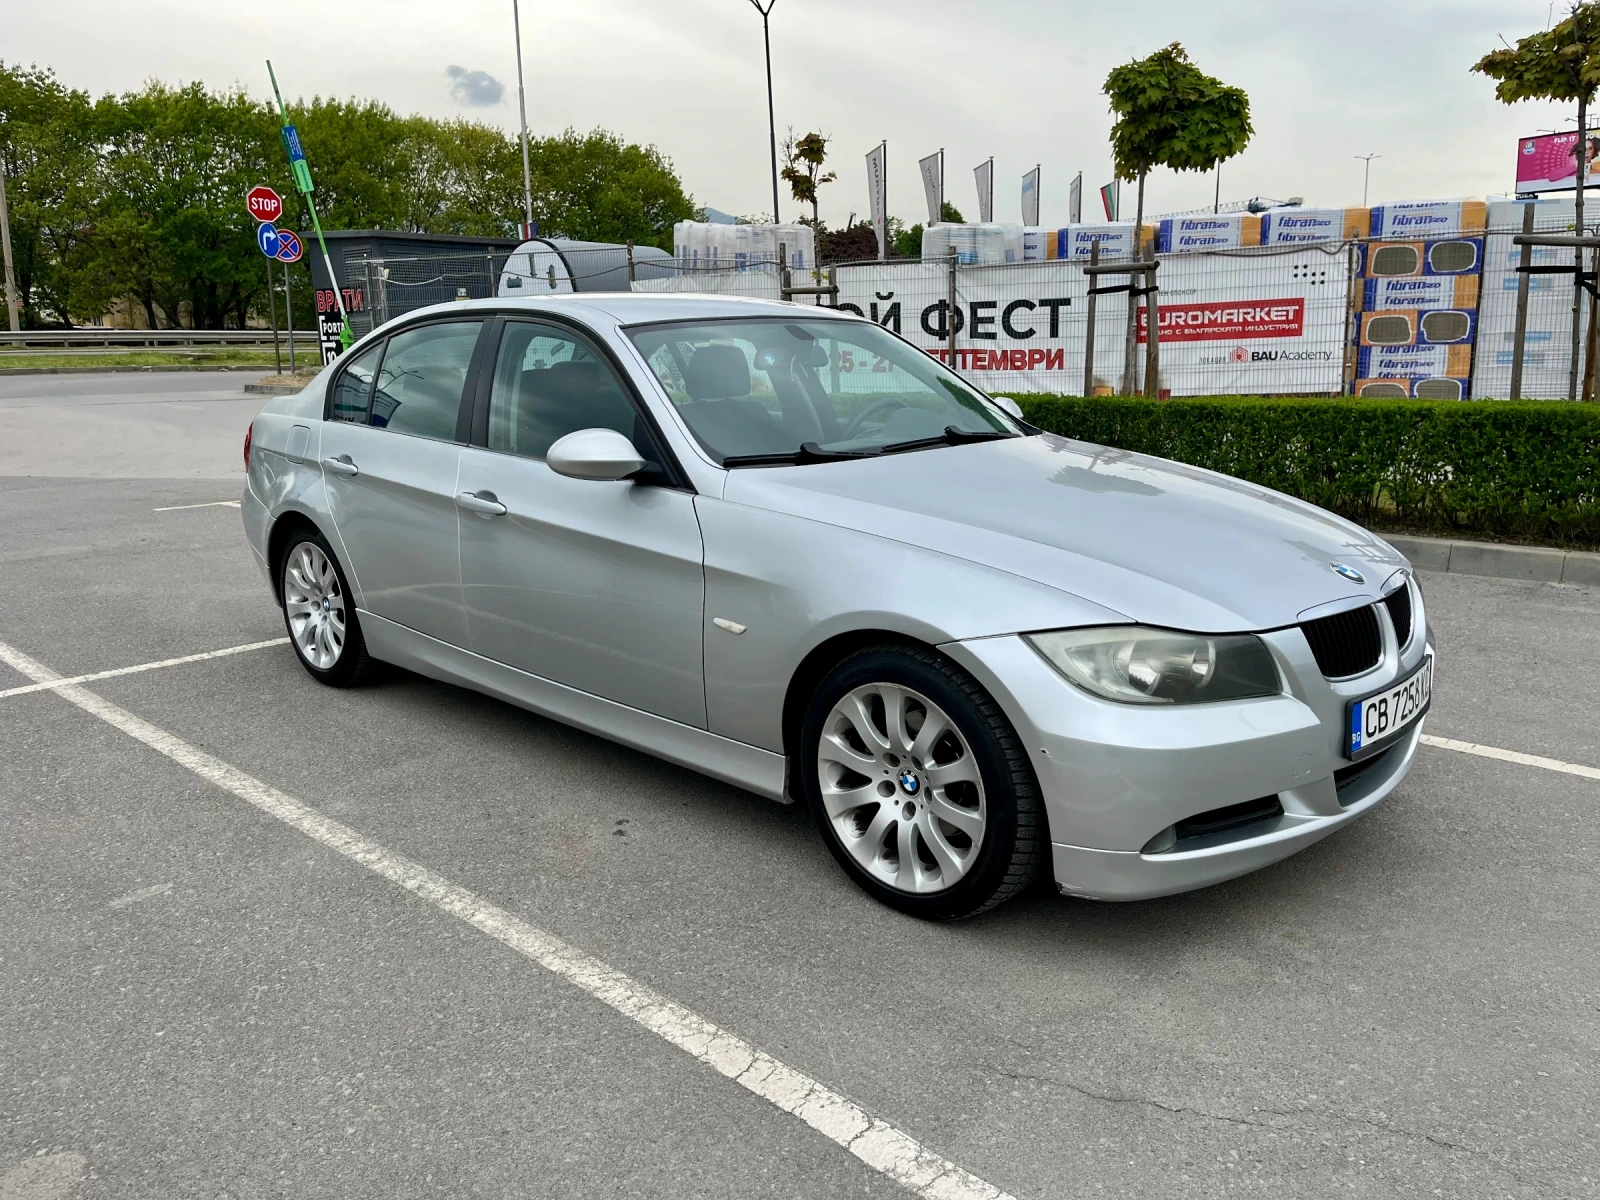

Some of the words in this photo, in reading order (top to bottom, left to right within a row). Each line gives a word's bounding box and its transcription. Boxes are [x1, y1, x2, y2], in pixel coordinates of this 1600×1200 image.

[251, 197, 278, 212] STOP
[920, 298, 1071, 341] ФЕСТ
[1252, 350, 1278, 361] BAU
[1280, 349, 1332, 361] Academy
[1366, 697, 1389, 738] CB
[1392, 676, 1420, 728] 7258
[1352, 731, 1361, 744] BG
